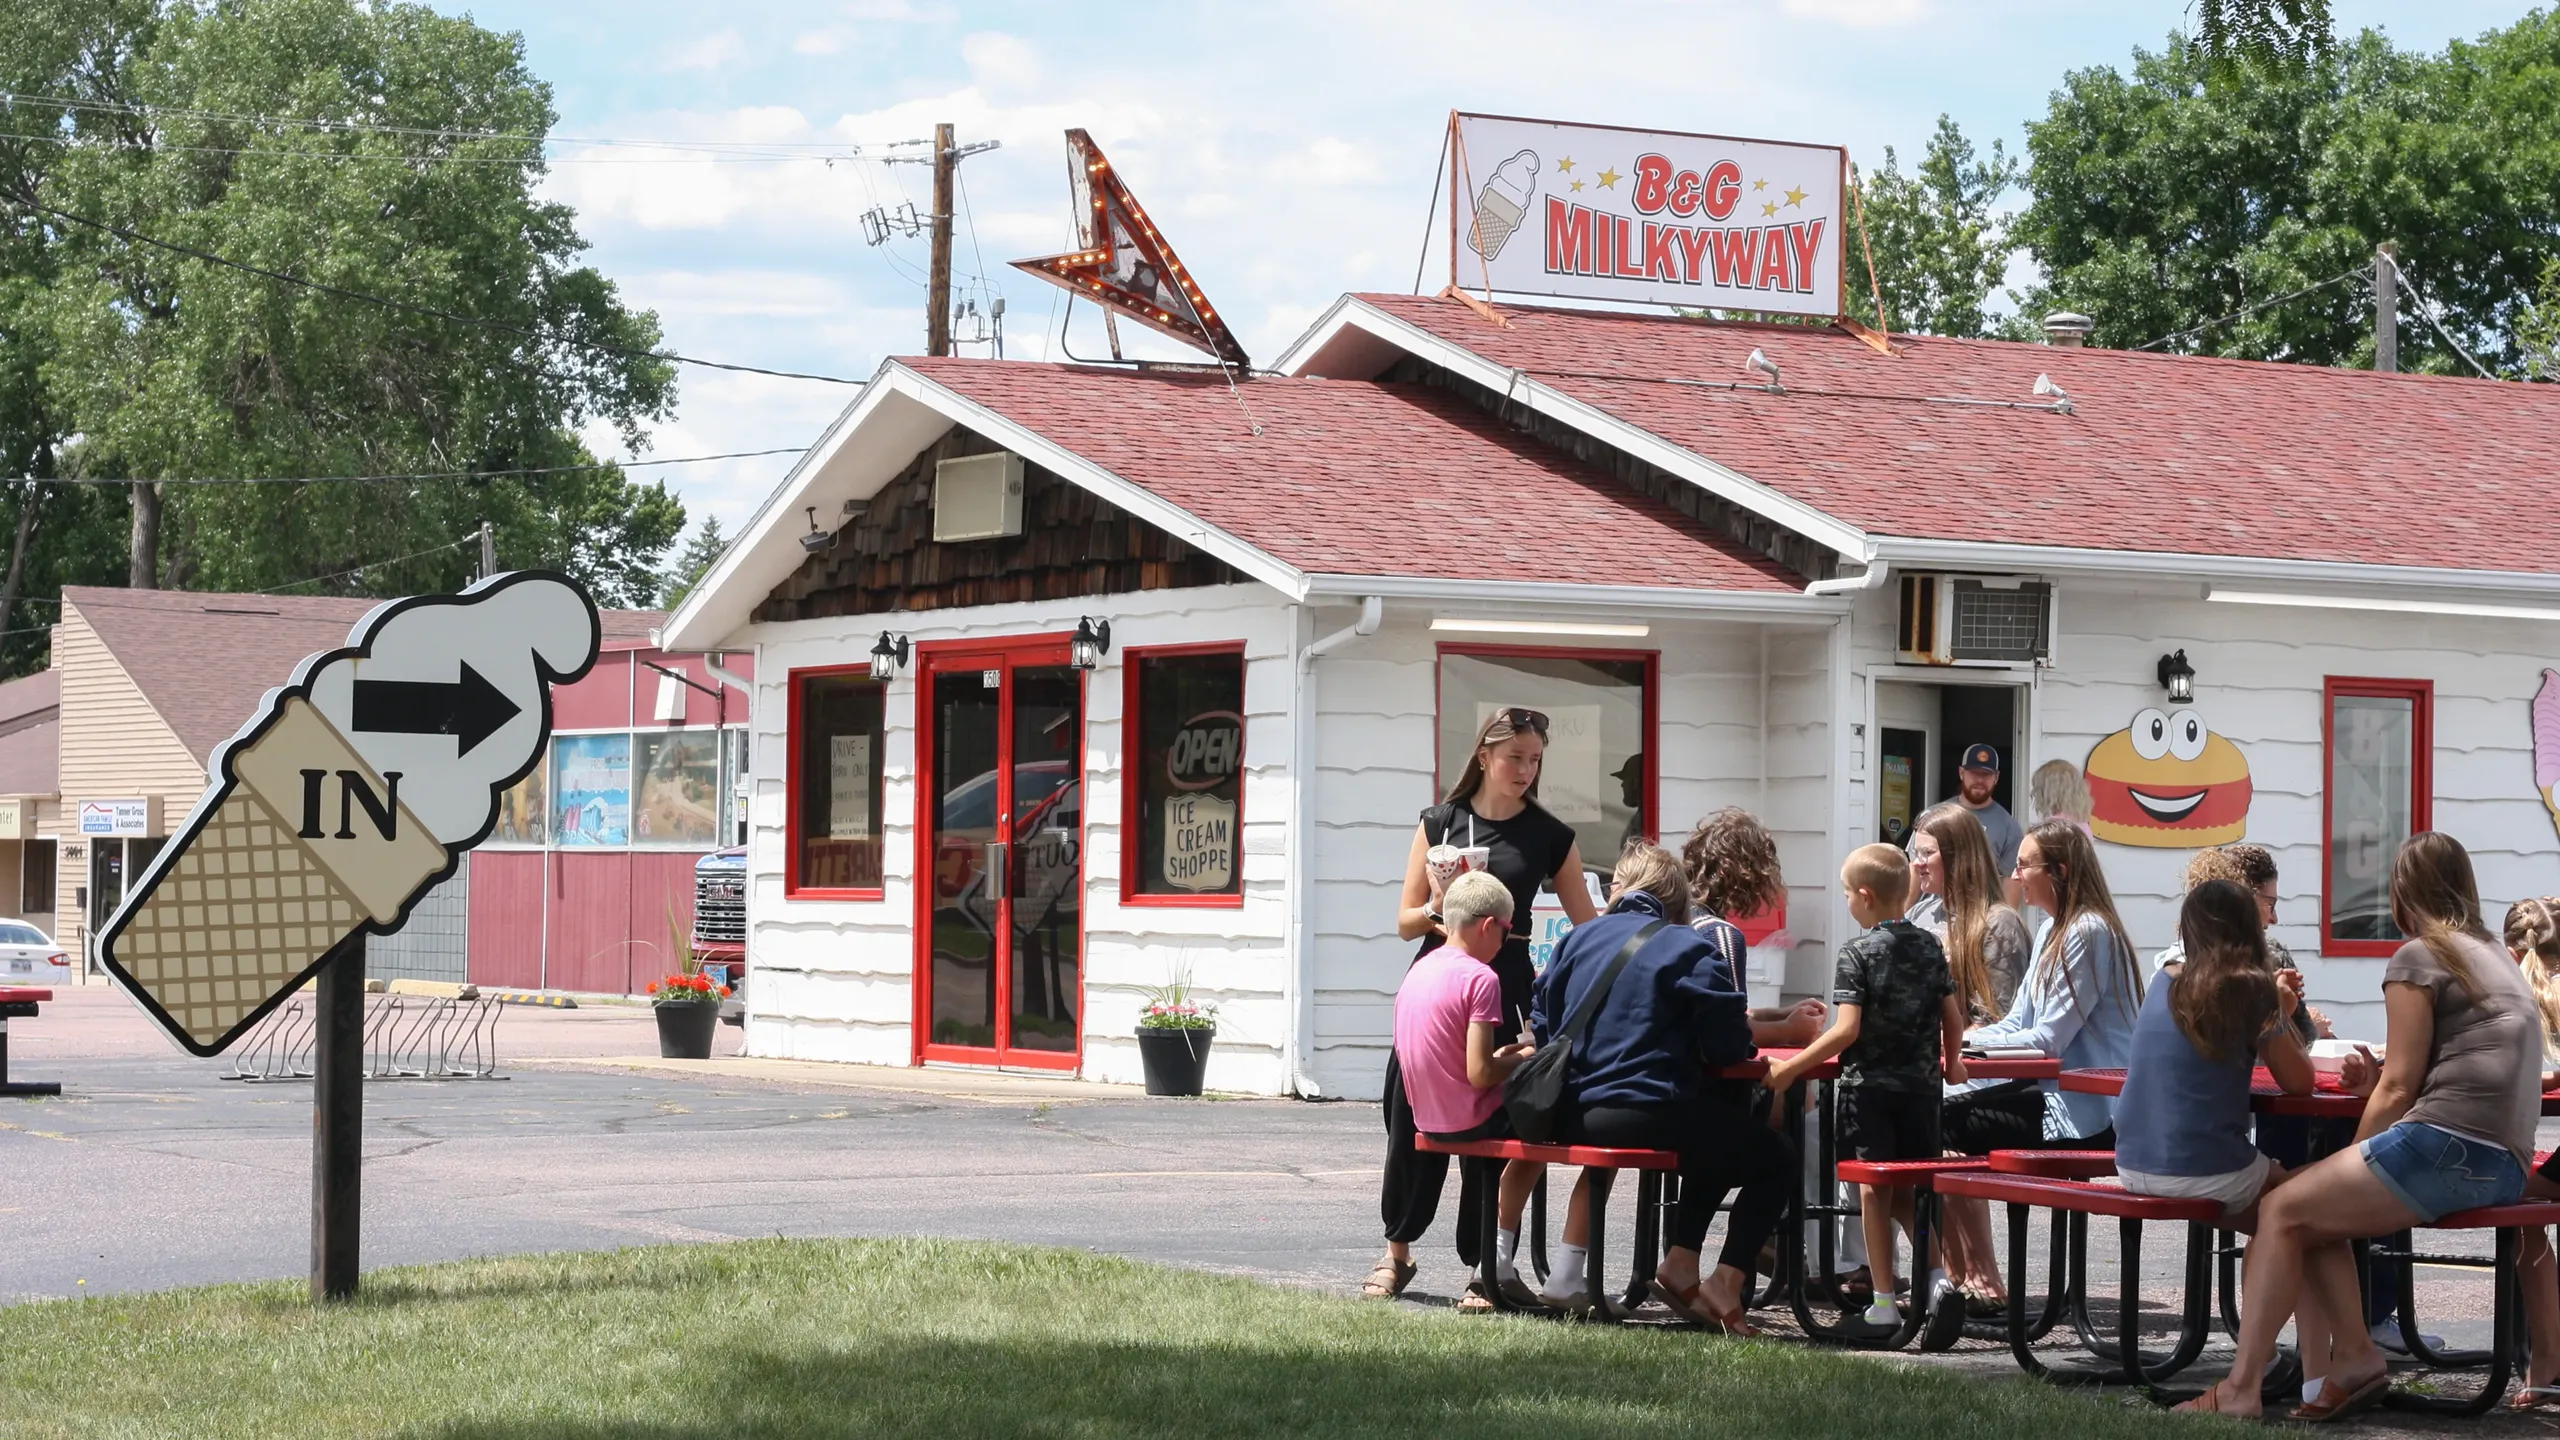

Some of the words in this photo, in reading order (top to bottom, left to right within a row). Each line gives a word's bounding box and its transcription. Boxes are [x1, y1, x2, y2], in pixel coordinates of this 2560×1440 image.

[1634, 152, 1743, 221] B&G
[1545, 194, 1826, 294] MILKYWAY
[1550, 716, 1585, 739] HRU
[1173, 728, 1240, 775] OPEN
[297, 769, 403, 841] IN
[1172, 801, 1195, 825] ICE
[1177, 819, 1227, 852] CREAM
[1169, 849, 1228, 879] SHOPPE
[708, 884, 743, 900] GMC
[1545, 917, 1573, 941] IC
